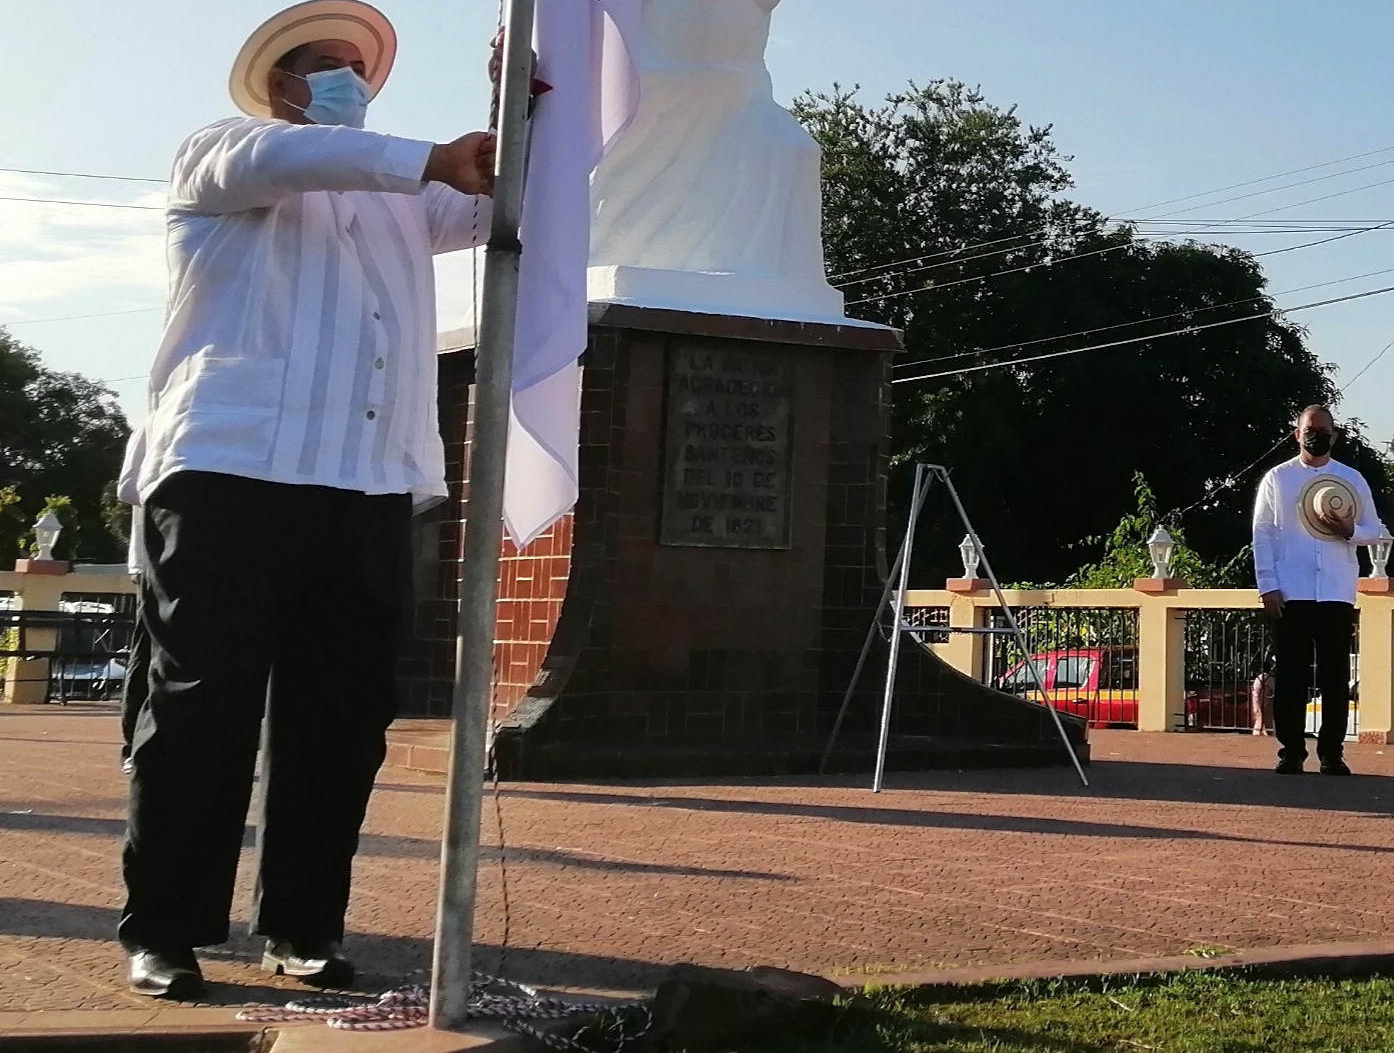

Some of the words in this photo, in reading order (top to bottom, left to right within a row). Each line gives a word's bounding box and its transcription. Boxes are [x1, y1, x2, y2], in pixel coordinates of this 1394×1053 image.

[689, 354, 714, 371] LA
[705, 399, 717, 417] A
[725, 400, 760, 419] LOS
[684, 467, 715, 487] DEL
[753, 471, 776, 489] DE
[677, 490, 778, 513] NOVIEMBRE
[691, 515, 714, 535] DE
